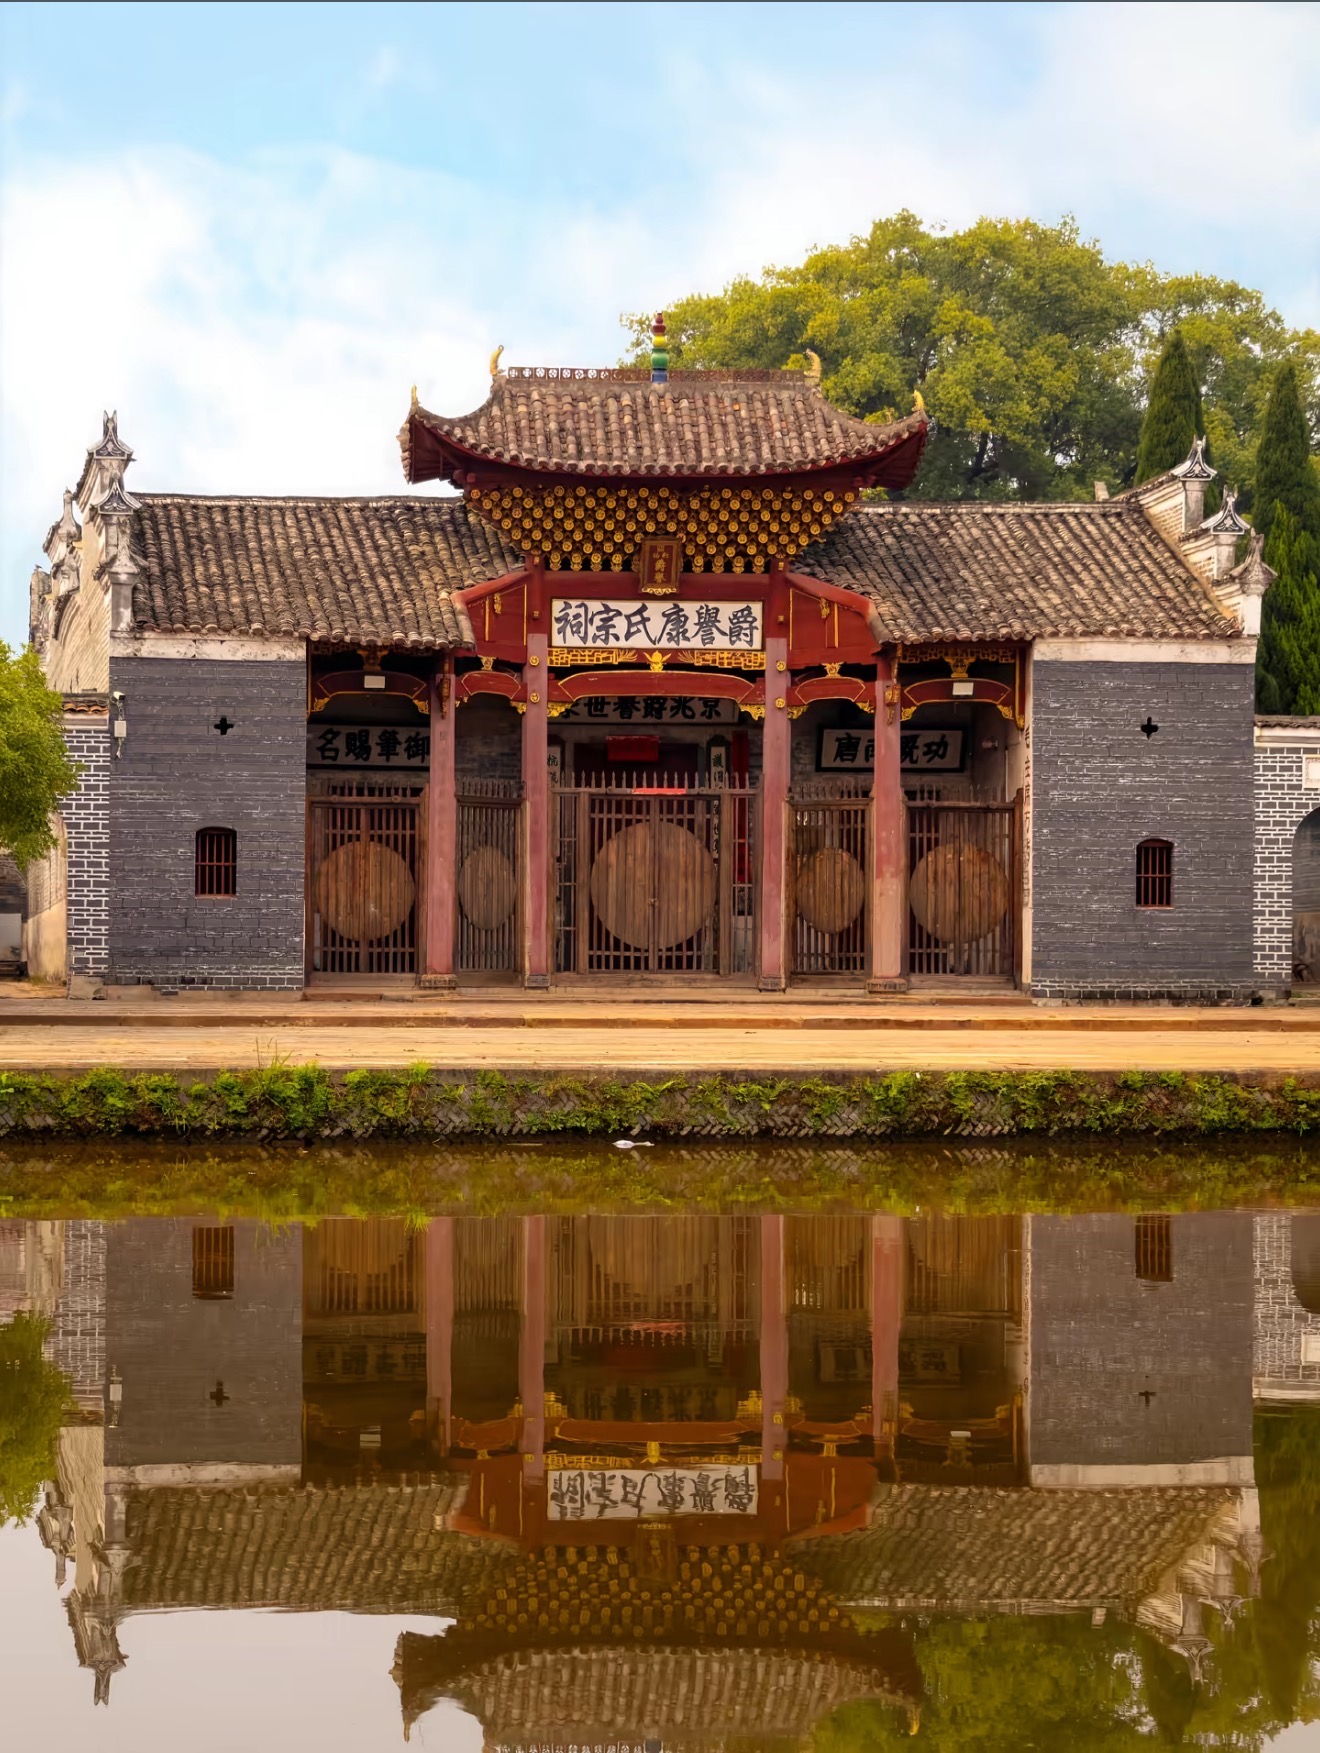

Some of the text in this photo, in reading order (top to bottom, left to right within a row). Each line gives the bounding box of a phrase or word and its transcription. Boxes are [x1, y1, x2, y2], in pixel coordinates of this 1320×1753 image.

[554, 601, 759, 647] 爵譽康氏宗祠
[560, 696, 721, 720] 京兆爵譽世
